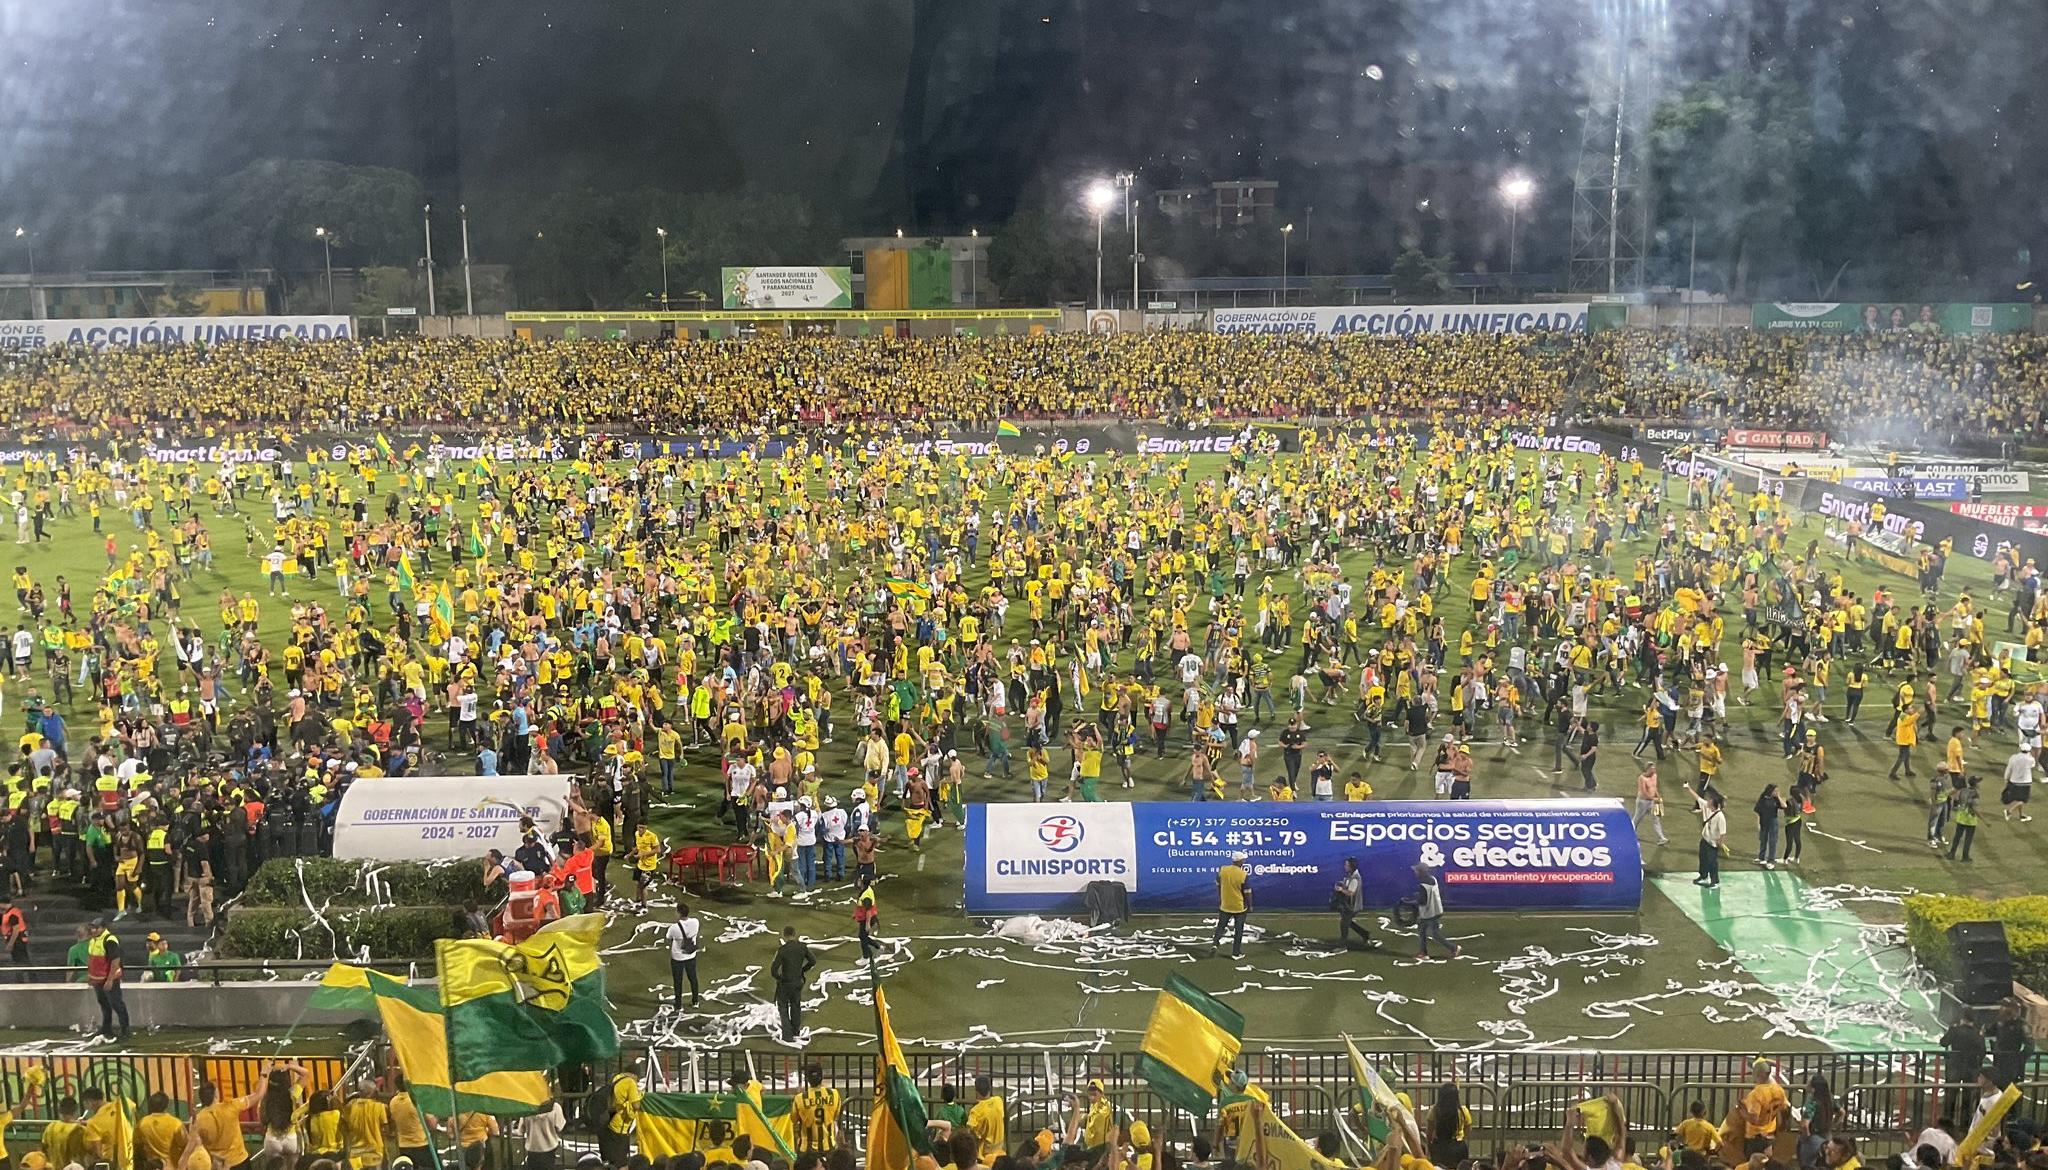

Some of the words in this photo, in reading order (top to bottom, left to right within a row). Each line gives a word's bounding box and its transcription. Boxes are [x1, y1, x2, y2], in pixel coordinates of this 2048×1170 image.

[1215, 309, 1298, 323] GOBERNACIÓN
[1301, 312, 1316, 321] DE
[1330, 307, 1434, 335] ACCIÓN
[1441, 312, 1587, 335] UNIFICADA
[26, 325, 45, 335] DE
[67, 320, 184, 349] ACCIÓN
[194, 323, 350, 346] UNIFICADA
[1215, 322, 1317, 335] SANTANDER
[1647, 429, 1691, 441] BetPlay
[1960, 503, 2020, 516] MUEBLES
[2023, 506, 2033, 517] &
[363, 804, 448, 820] GOBERNACIÓN
[451, 808, 466, 819] DE
[1167, 818, 1201, 828] (+57)
[1205, 818, 1226, 827] 317
[1231, 818, 1290, 827] 5003250
[422, 827, 454, 839] 2024
[467, 826, 499, 838] 2027
[1153, 831, 1183, 846] Cl.
[1190, 831, 1219, 846] 54
[1279, 831, 1308, 846] 79
[1330, 819, 1471, 846] Espacios
[1478, 822, 1607, 846] seguros
[1420, 842, 1446, 867] &
[1452, 839, 1612, 867] efectivos
[996, 857, 1126, 877] CLINISPORTS
[1254, 863, 1318, 875] @clinisports
[1447, 873, 1468, 882] para
[1483, 872, 1540, 880] tratamiento
[1549, 872, 1612, 882] recuperación.
[814, 1108, 824, 1125] 9
